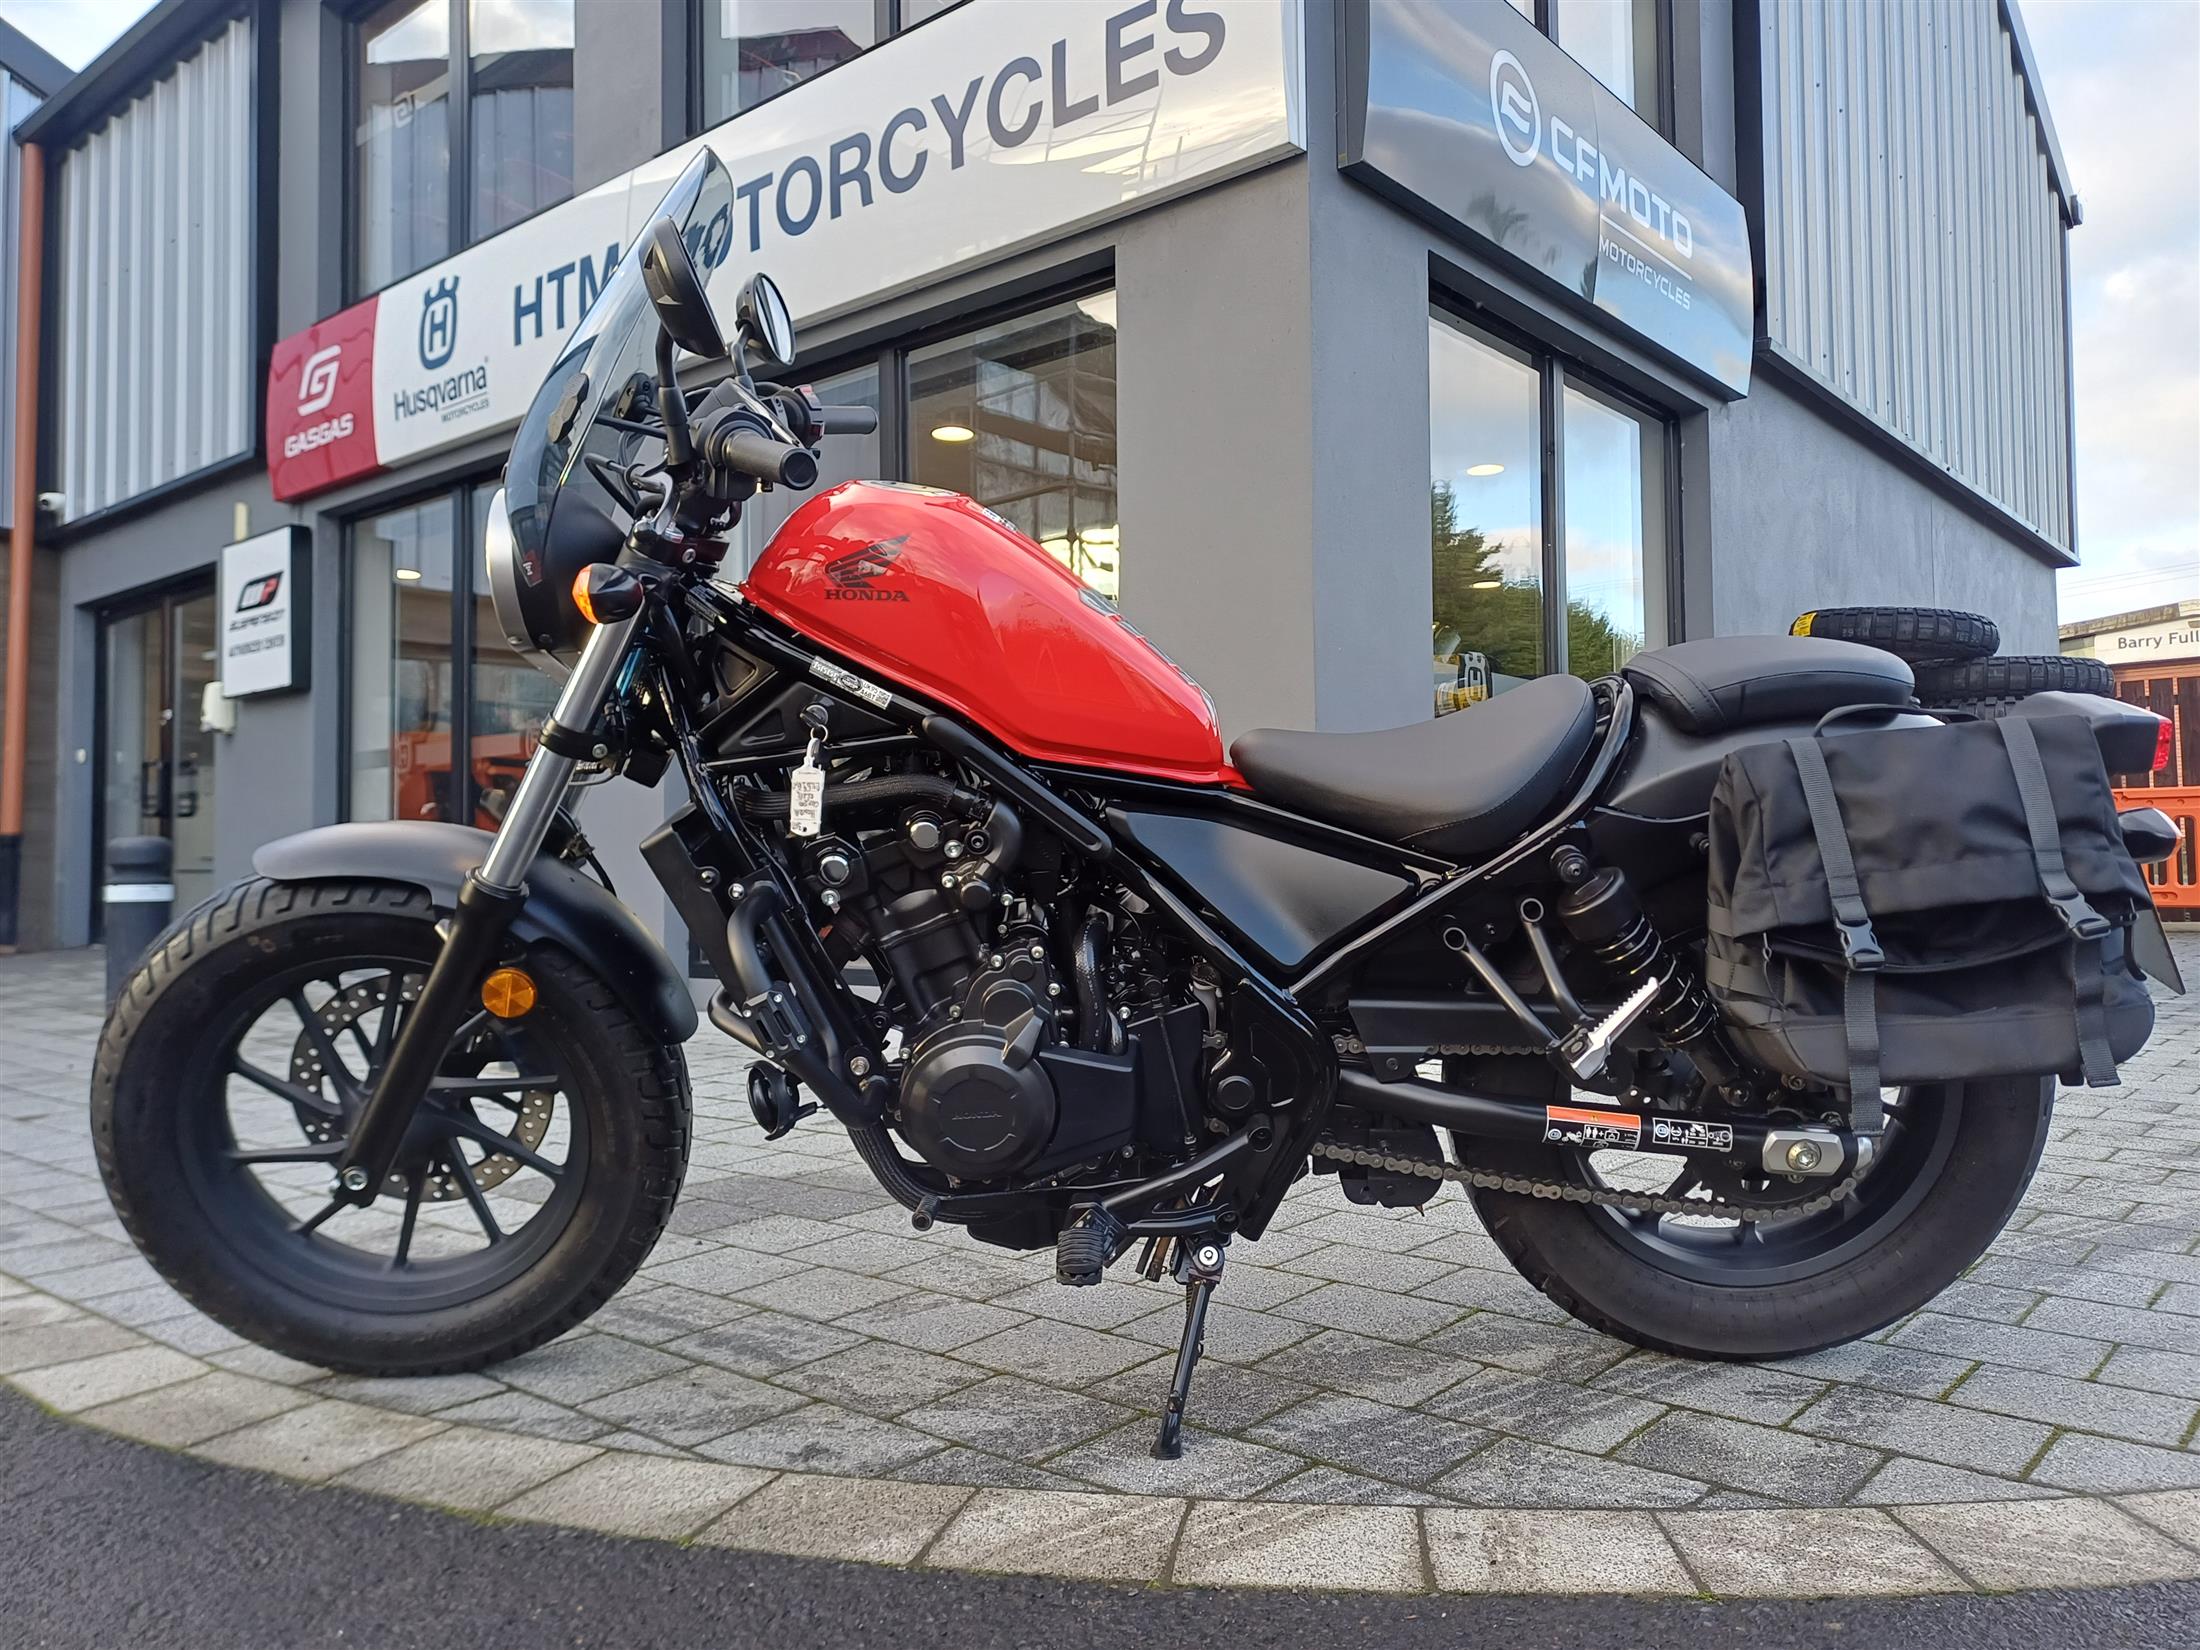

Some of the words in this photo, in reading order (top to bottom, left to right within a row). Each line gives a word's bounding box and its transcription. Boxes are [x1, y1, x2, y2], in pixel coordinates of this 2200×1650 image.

[686, 0, 1226, 270] OTORCYCLES
[1550, 114, 1694, 260] CFMOTO
[1598, 233, 1692, 311] MOTORCYCLES
[393, 364, 488, 422] Husqvarna
[284, 412, 355, 459] GASGAS
[824, 588, 911, 602] HONDA
[2117, 636, 2163, 650] Barry
